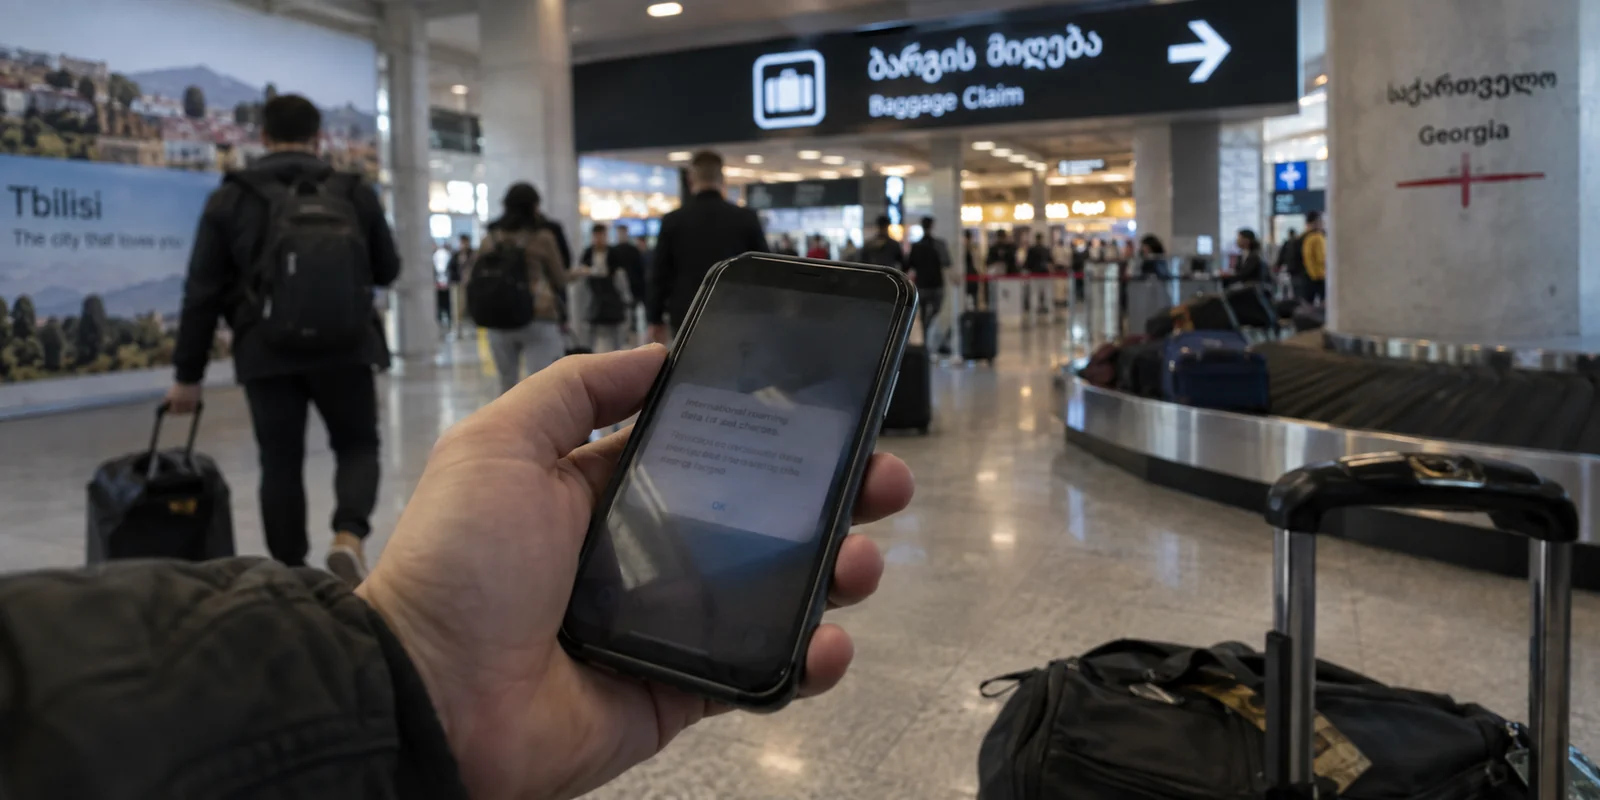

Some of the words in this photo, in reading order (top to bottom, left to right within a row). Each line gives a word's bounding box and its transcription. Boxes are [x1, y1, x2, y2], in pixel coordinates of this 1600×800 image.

[868, 37, 976, 83] ბარგის
[986, 23, 1103, 71] მიღება
[869, 92, 958, 119] Baggage
[962, 83, 1024, 110] Claim
[1387, 71, 1558, 108] საქართველო
[1418, 118, 1510, 147] Georgia
[7, 184, 102, 221] Tbilisi
[13, 228, 46, 247] The
[51, 231, 79, 252] city
[84, 231, 114, 249] that
[711, 500, 727, 512] OK
